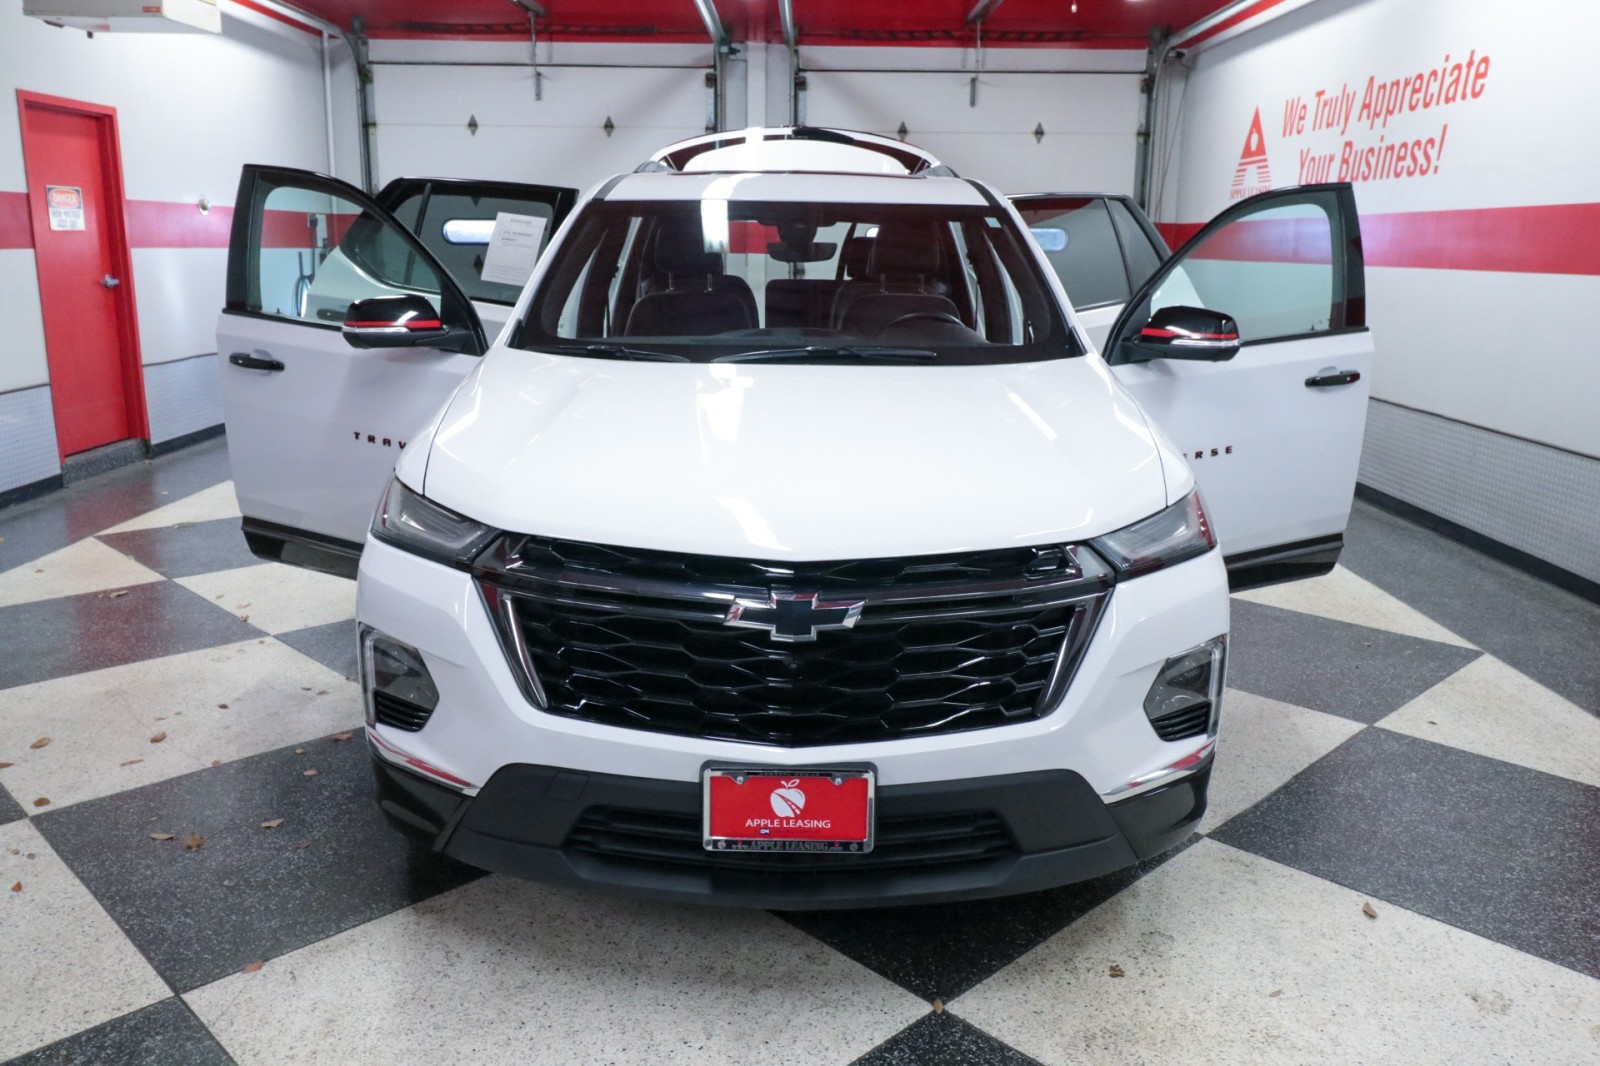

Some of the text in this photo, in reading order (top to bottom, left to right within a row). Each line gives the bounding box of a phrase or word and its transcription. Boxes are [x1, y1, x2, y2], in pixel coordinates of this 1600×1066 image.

[1282, 49, 1491, 138] We Truly Appreciate
[1298, 123, 1448, 186] Your Business!
[353, 431, 407, 450] TRAV
[745, 818, 831, 829] APPLE LEASING
